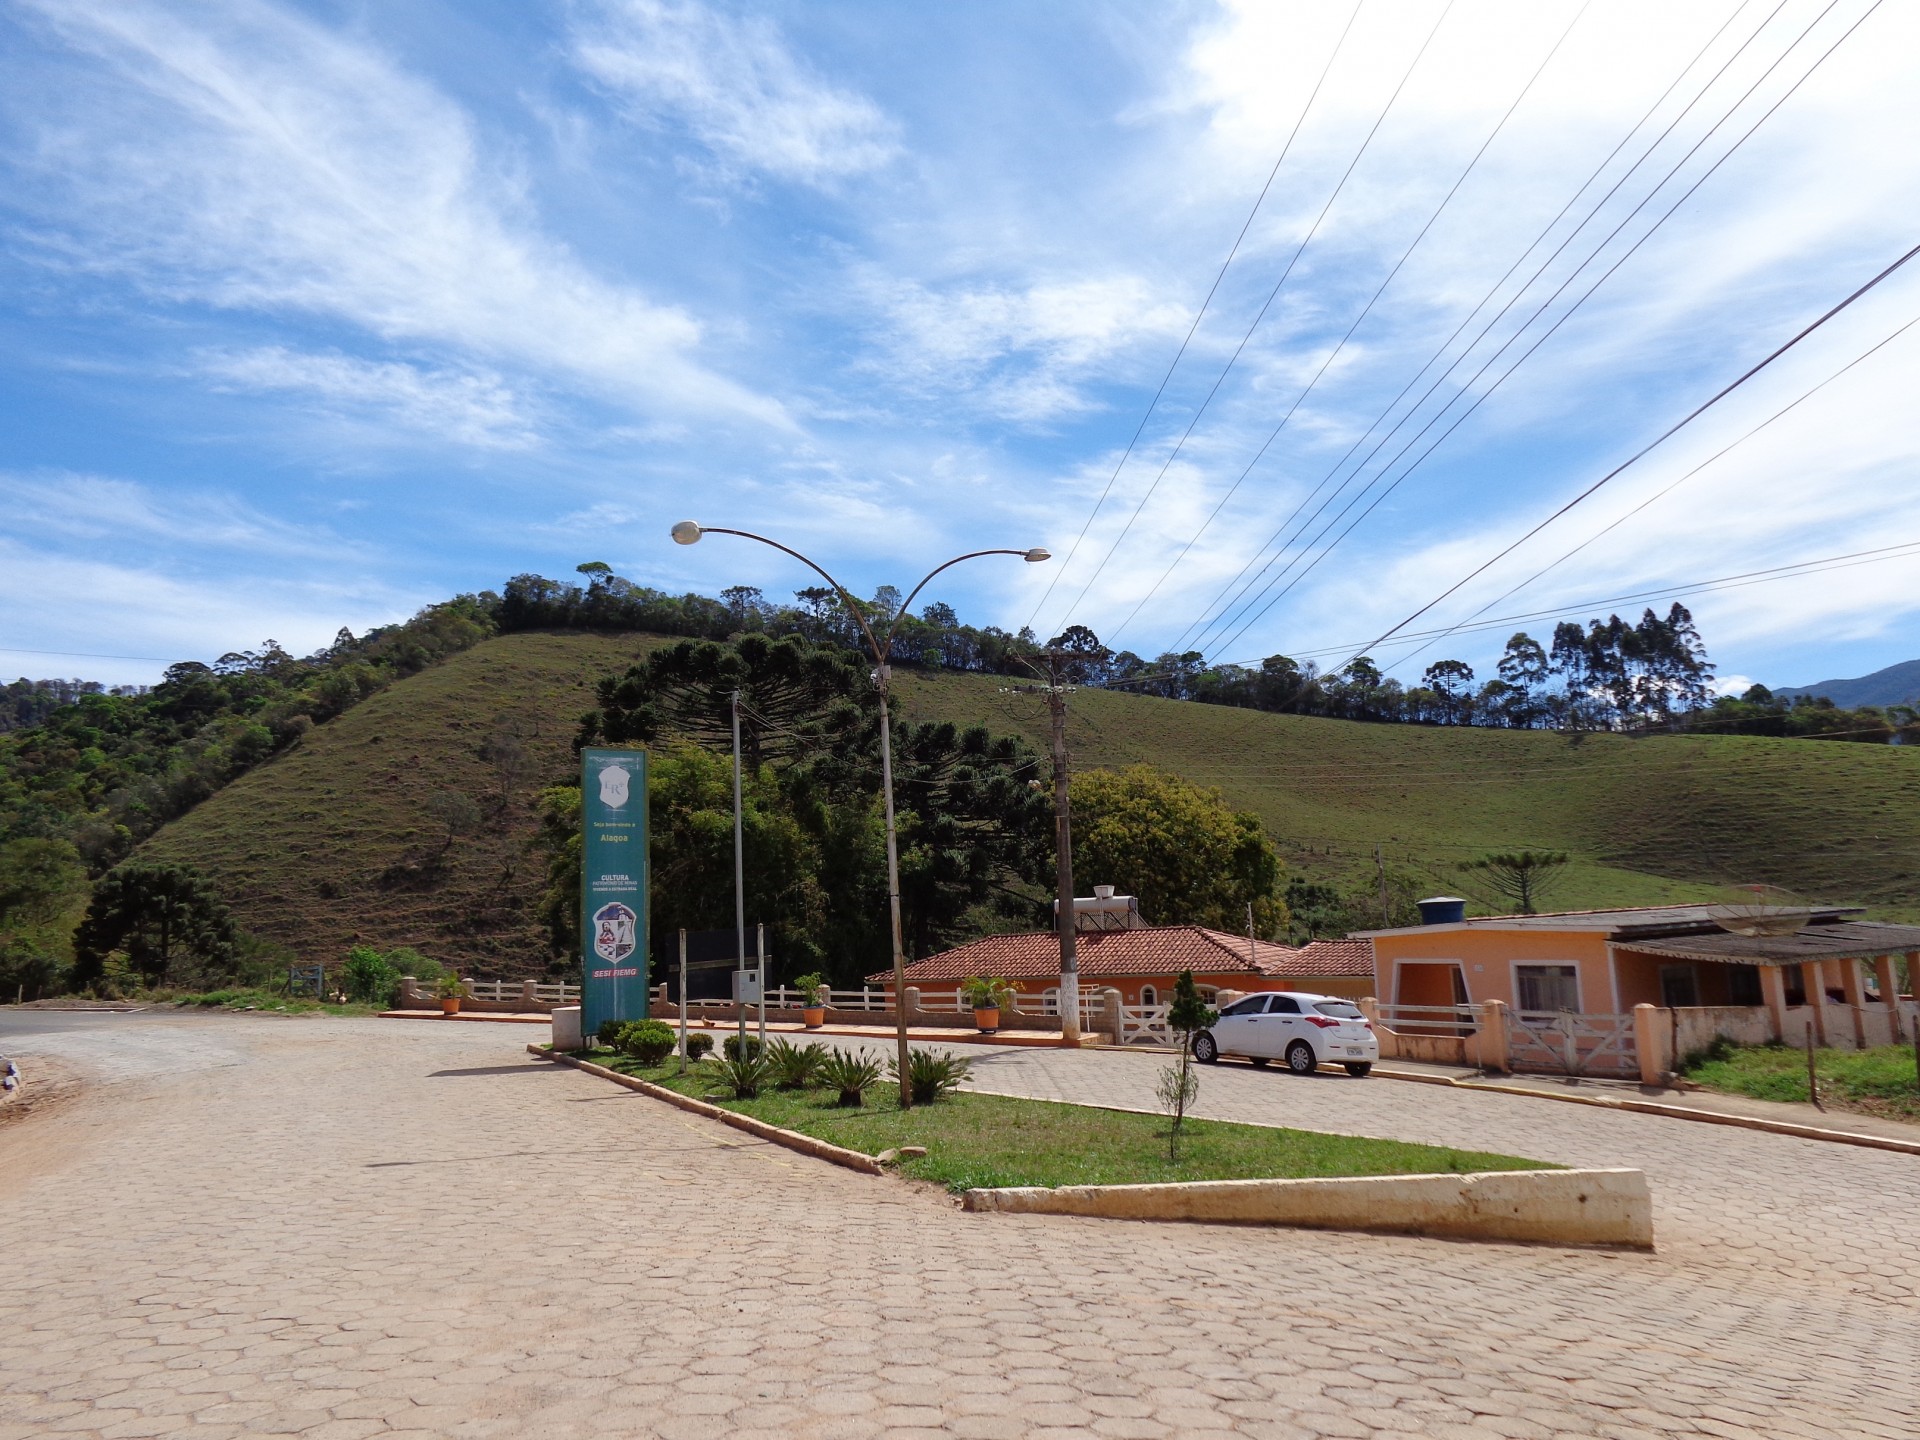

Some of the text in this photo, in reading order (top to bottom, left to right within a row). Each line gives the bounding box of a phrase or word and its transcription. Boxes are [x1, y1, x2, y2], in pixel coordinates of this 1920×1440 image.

[600, 833, 628, 843] Alagoa
[593, 968, 637, 978] SESI FIEMG
